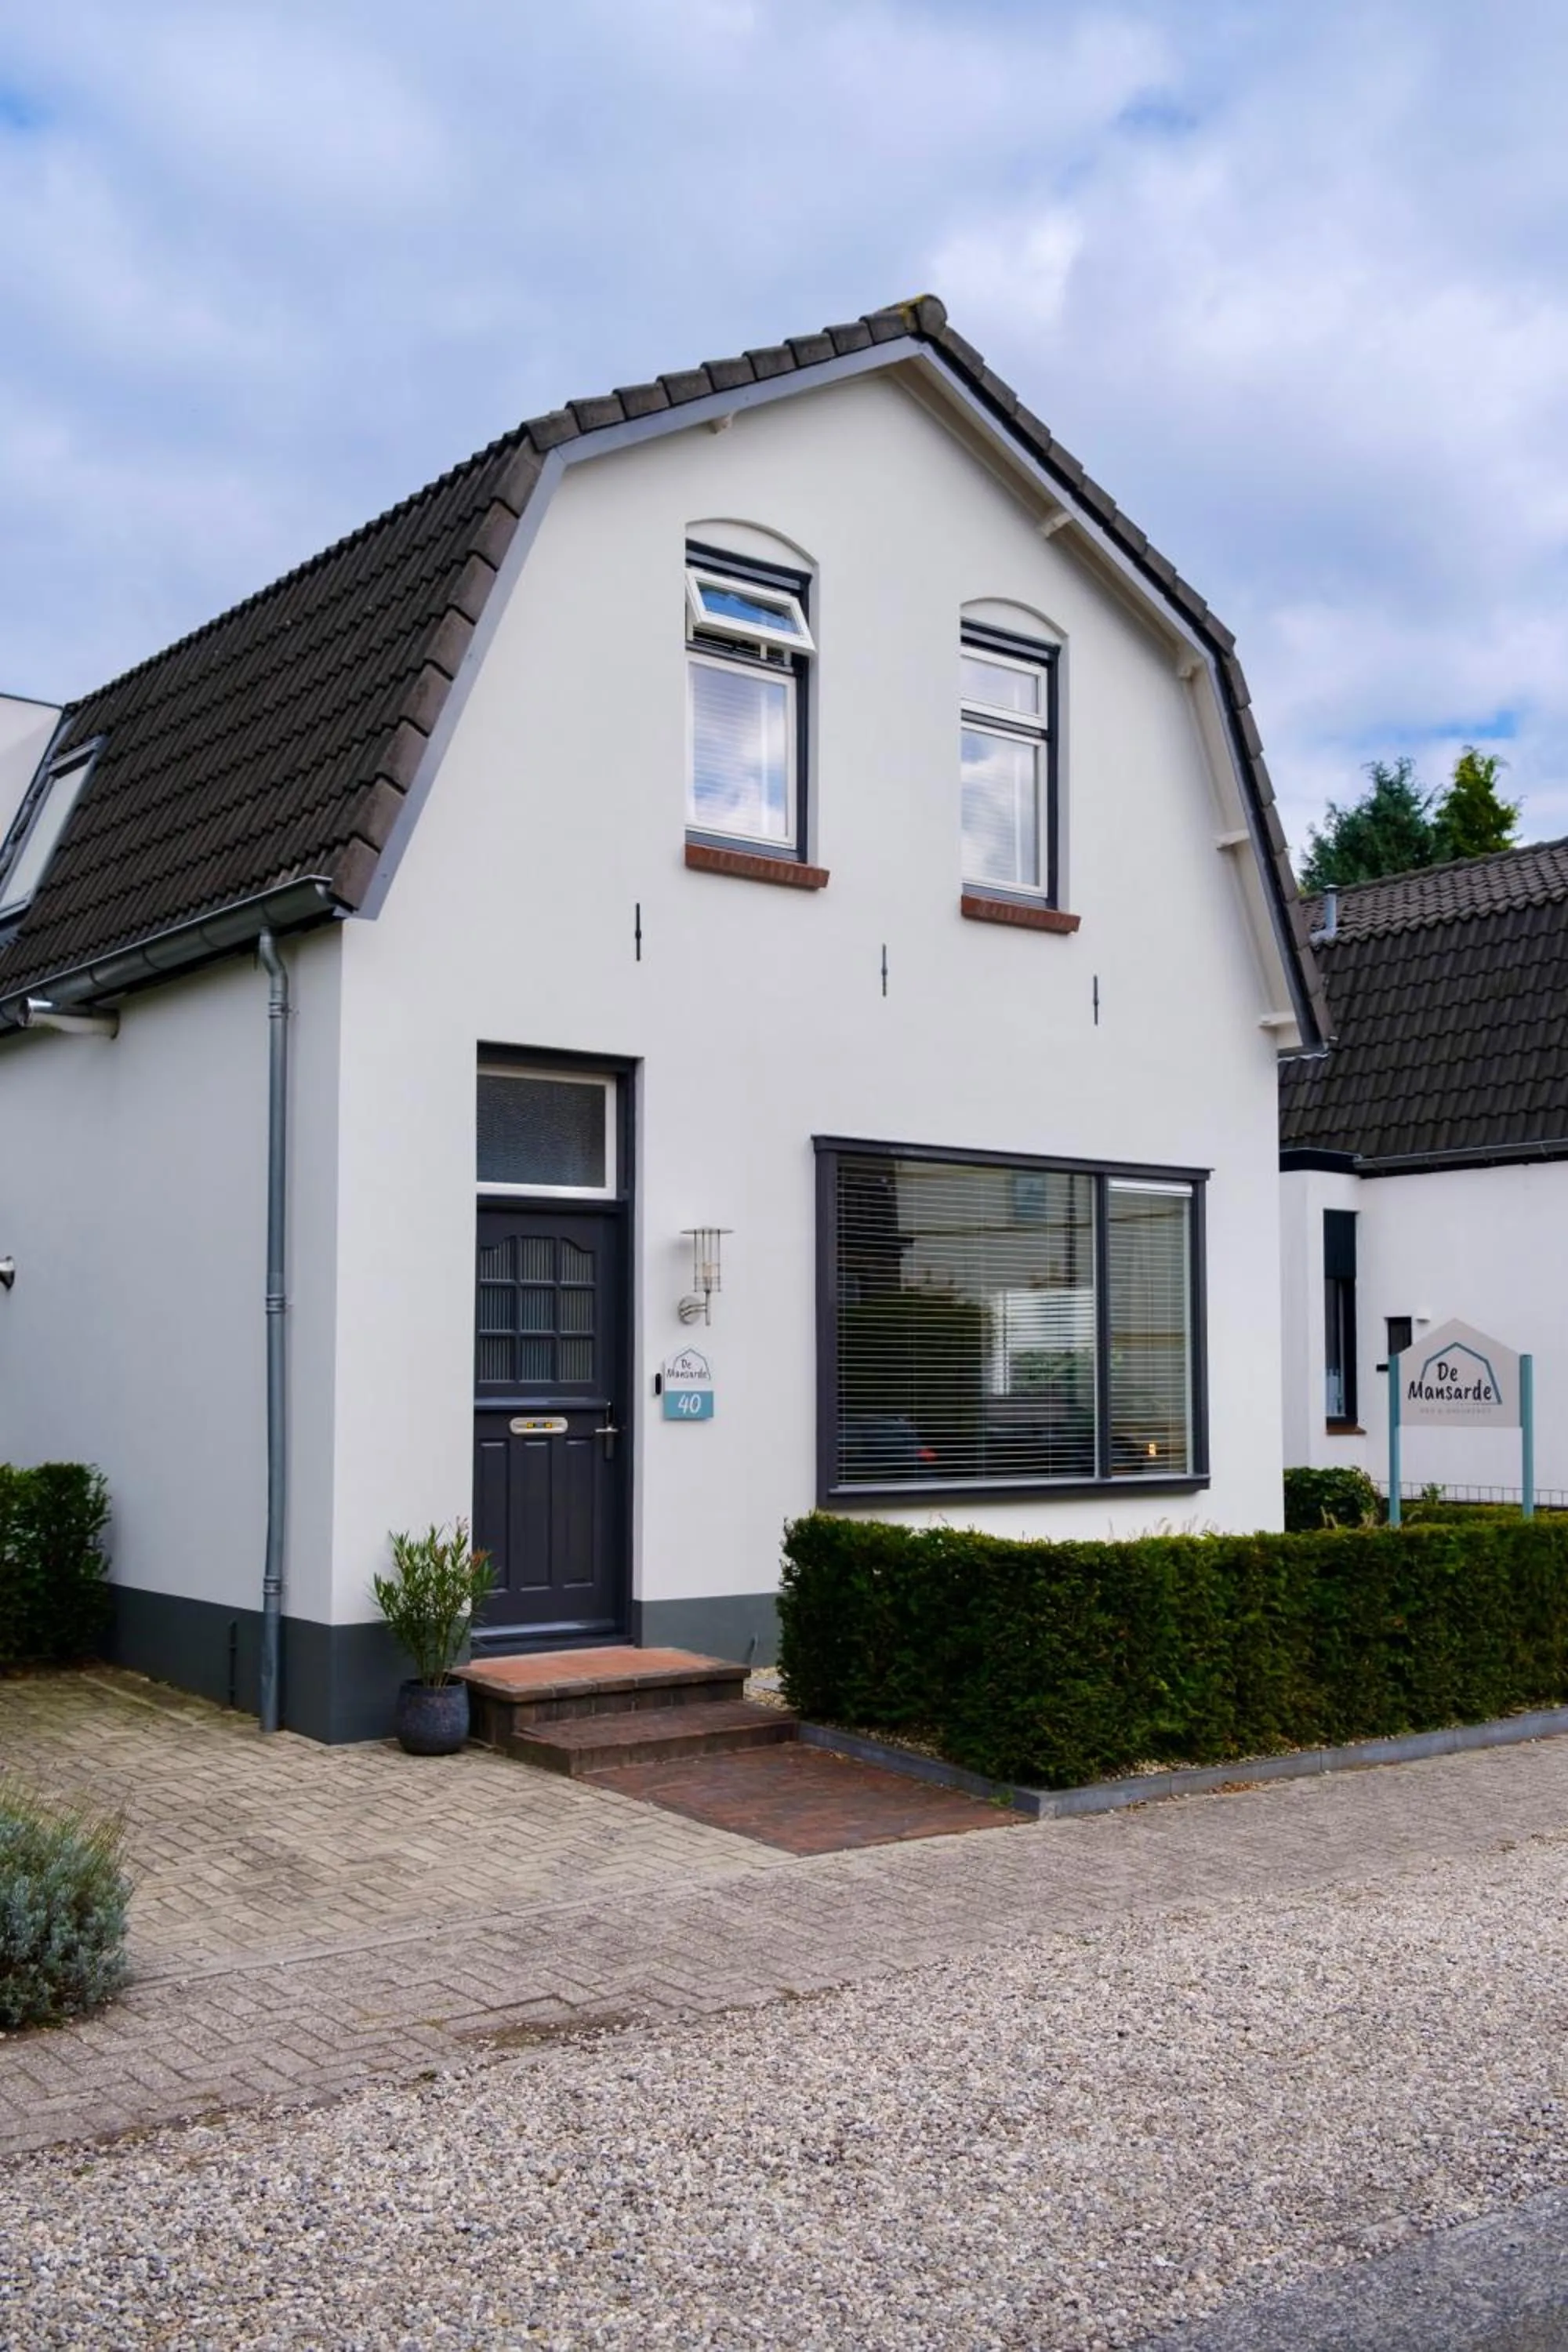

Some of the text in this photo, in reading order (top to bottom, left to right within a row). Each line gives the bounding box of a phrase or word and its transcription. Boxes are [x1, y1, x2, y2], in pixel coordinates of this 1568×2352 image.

[666, 1367, 707, 1379] Mansarde
[681, 1359, 691, 1369] De
[1437, 1362, 1458, 1381] De
[1407, 1379, 1492, 1400] Mansarde
[677, 1393, 702, 1414] 40
